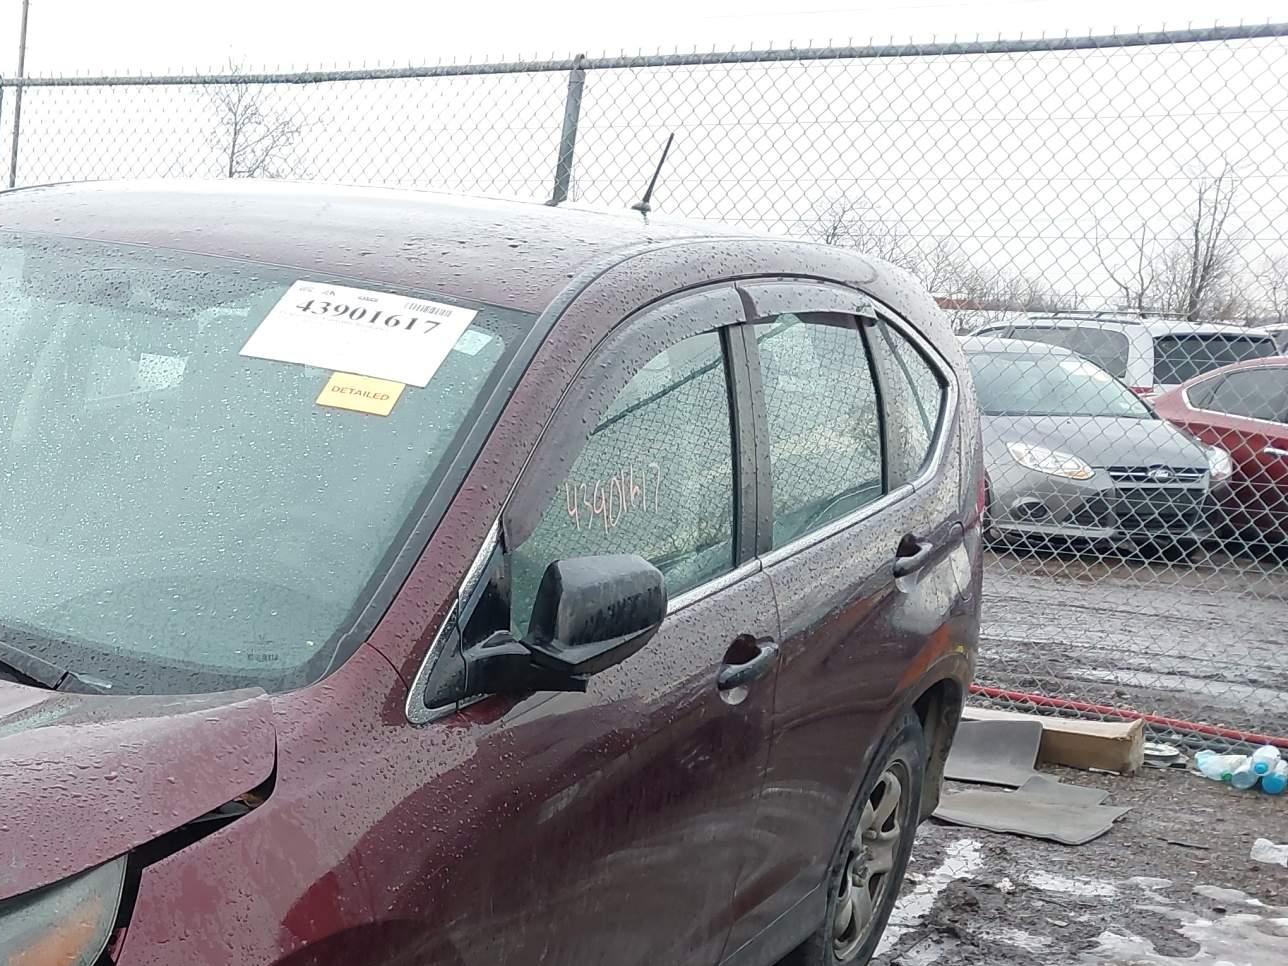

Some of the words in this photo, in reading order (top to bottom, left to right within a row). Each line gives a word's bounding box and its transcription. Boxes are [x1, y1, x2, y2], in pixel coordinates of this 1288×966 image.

[296, 299, 441, 334] 43901617
[331, 385, 390, 401] DETAILED
[565, 462, 661, 534] 43901617
